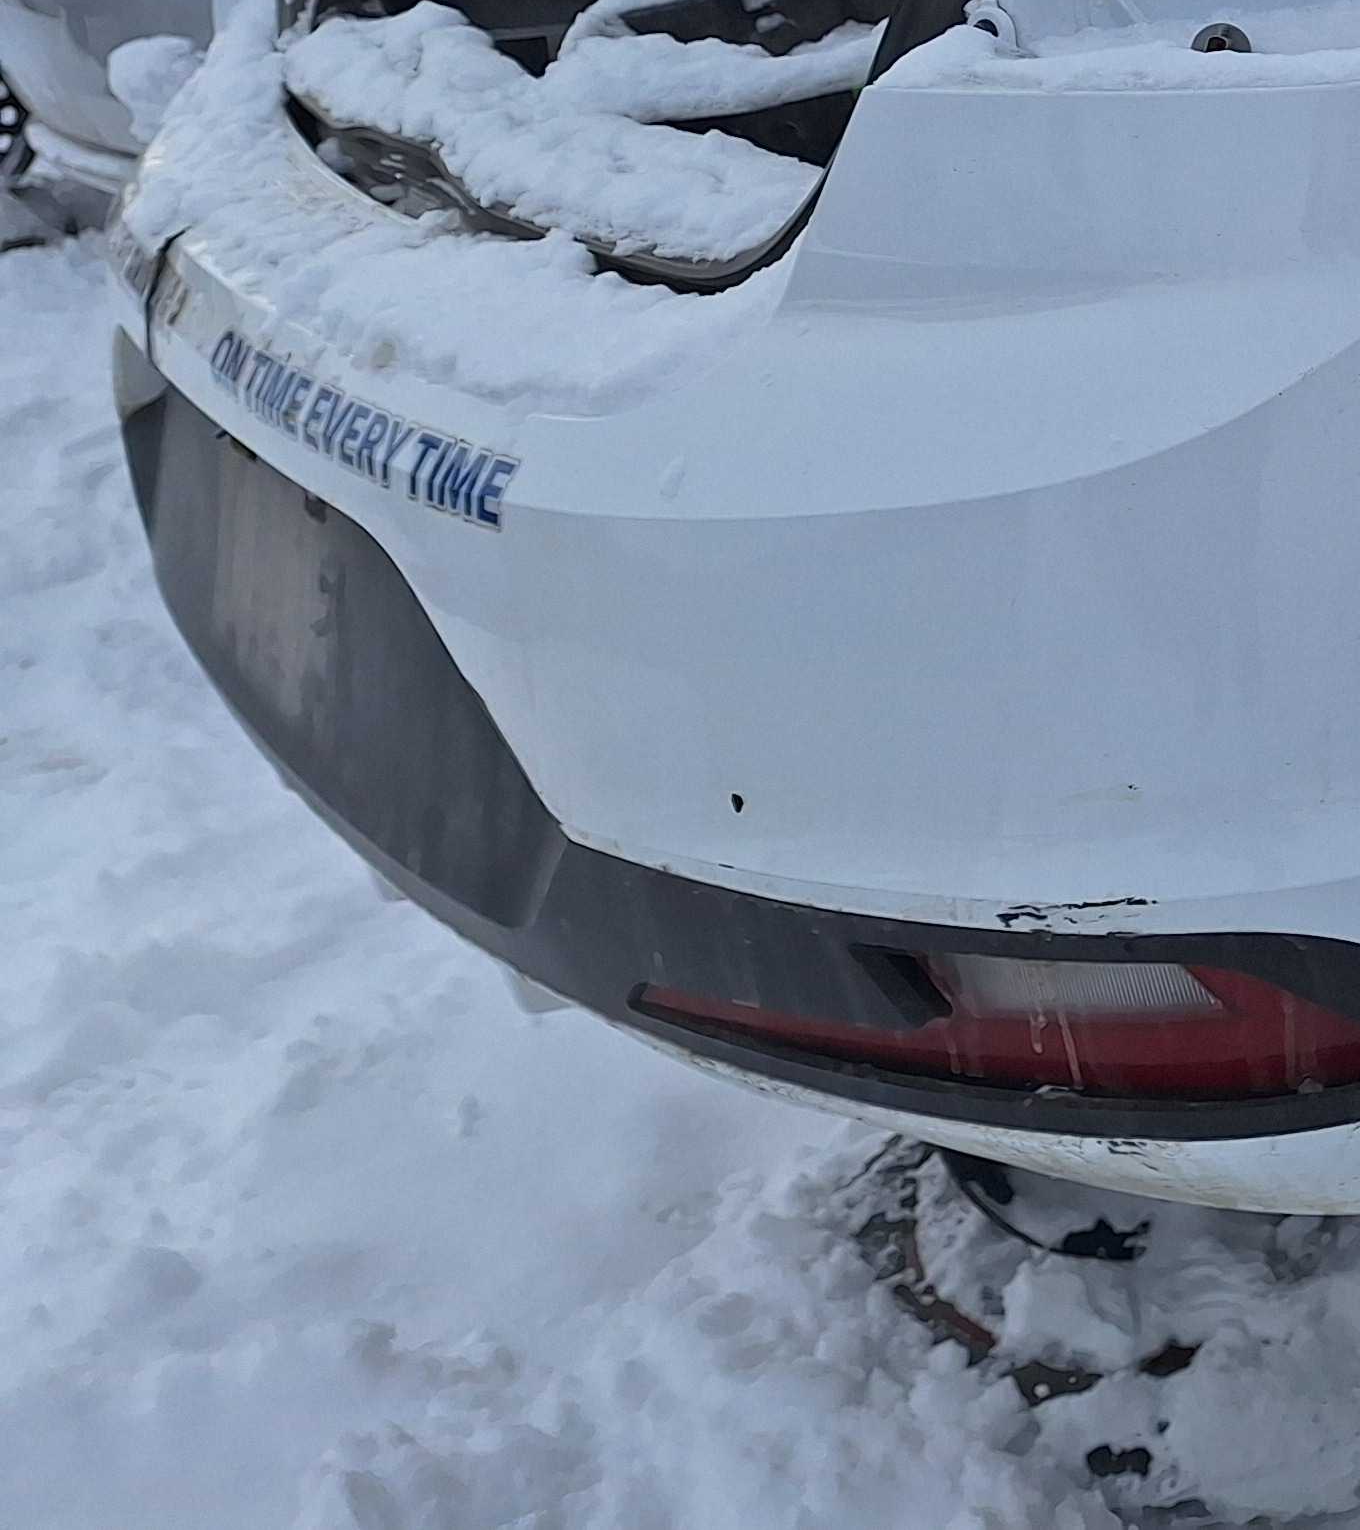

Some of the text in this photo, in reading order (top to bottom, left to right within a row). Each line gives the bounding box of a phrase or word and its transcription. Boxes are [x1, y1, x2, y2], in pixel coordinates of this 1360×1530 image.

[210, 330, 519, 528] ON TIME EVERY TIME
